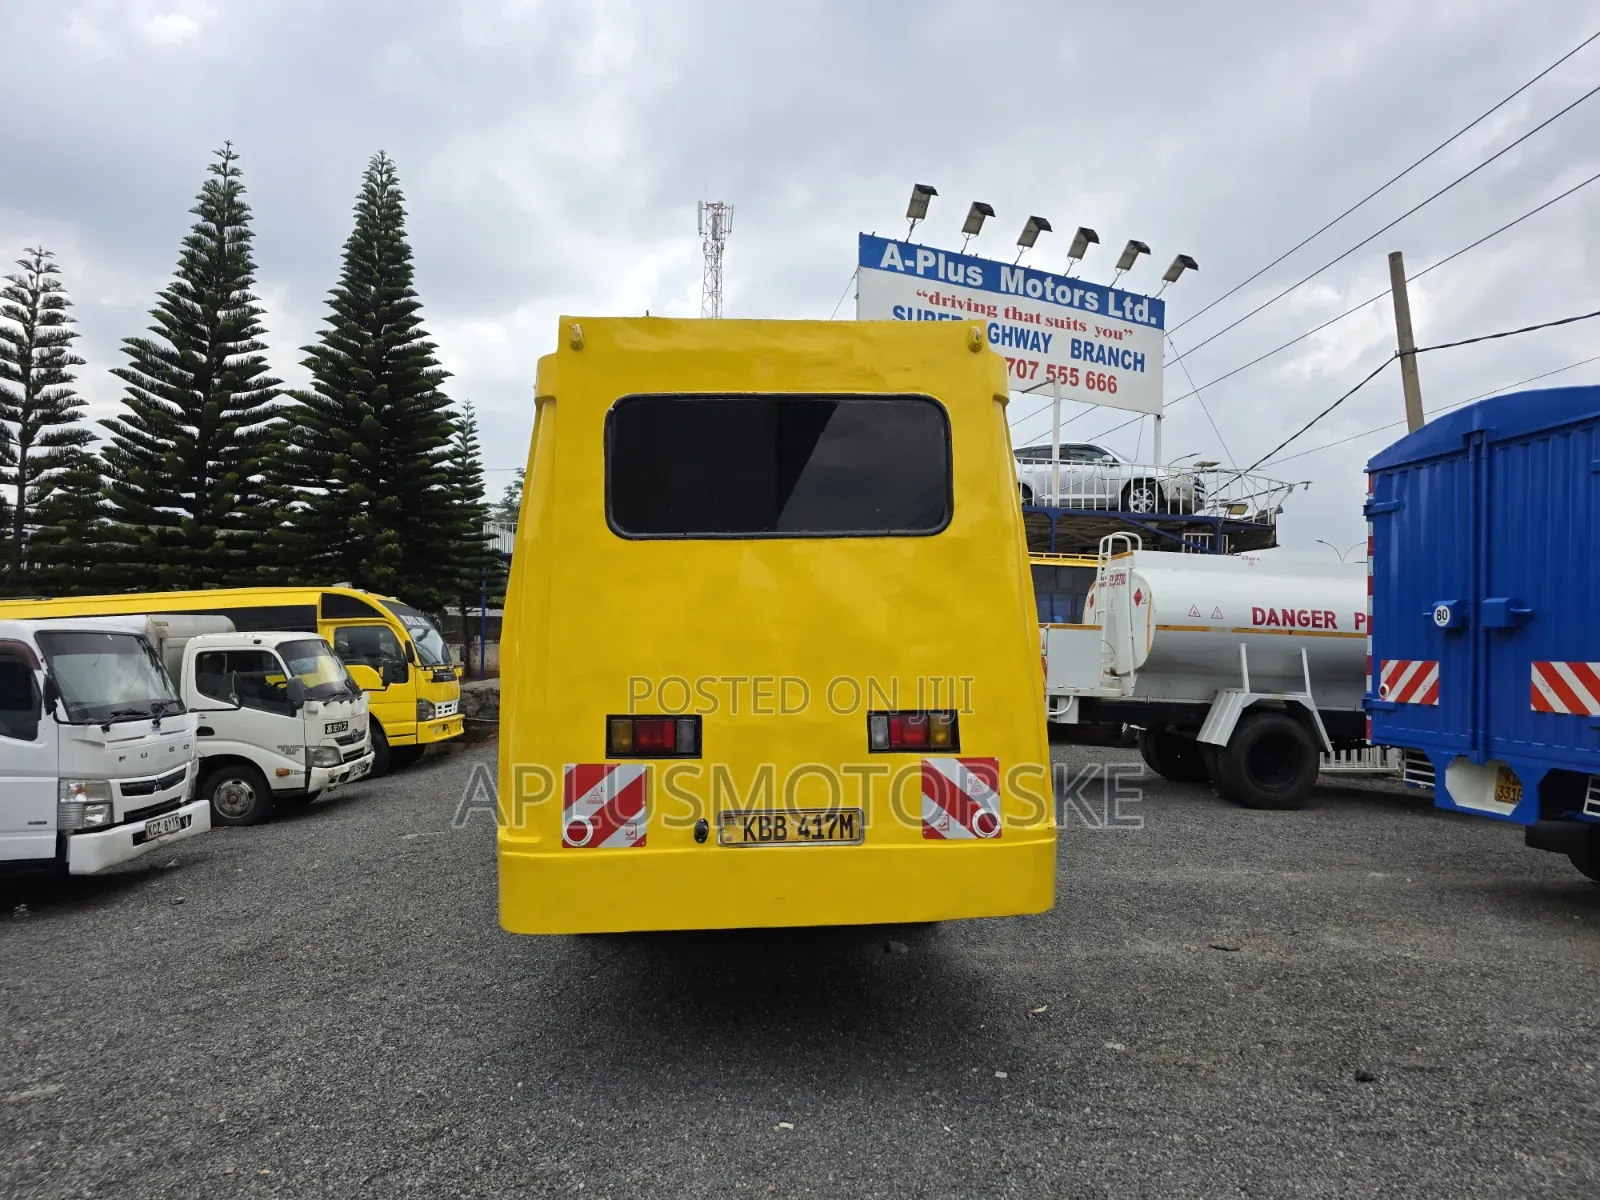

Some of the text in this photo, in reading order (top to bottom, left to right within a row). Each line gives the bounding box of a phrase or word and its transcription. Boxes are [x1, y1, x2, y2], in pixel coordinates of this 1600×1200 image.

[879, 242, 1157, 325] A-Plus Motors Ltd.
[1004, 305, 1043, 325] that
[1045, 316, 1088, 333] suits
[1070, 337, 1146, 373] BRANCH
[1045, 363, 1080, 388] 555
[1085, 370, 1119, 395] 666
[1251, 606, 1338, 630] DANGER
[1436, 609, 1448, 621] 80
[118, 743, 190, 762] FUSO
[147, 821, 162, 838] KCZ
[743, 813, 854, 842] KBB 417M
